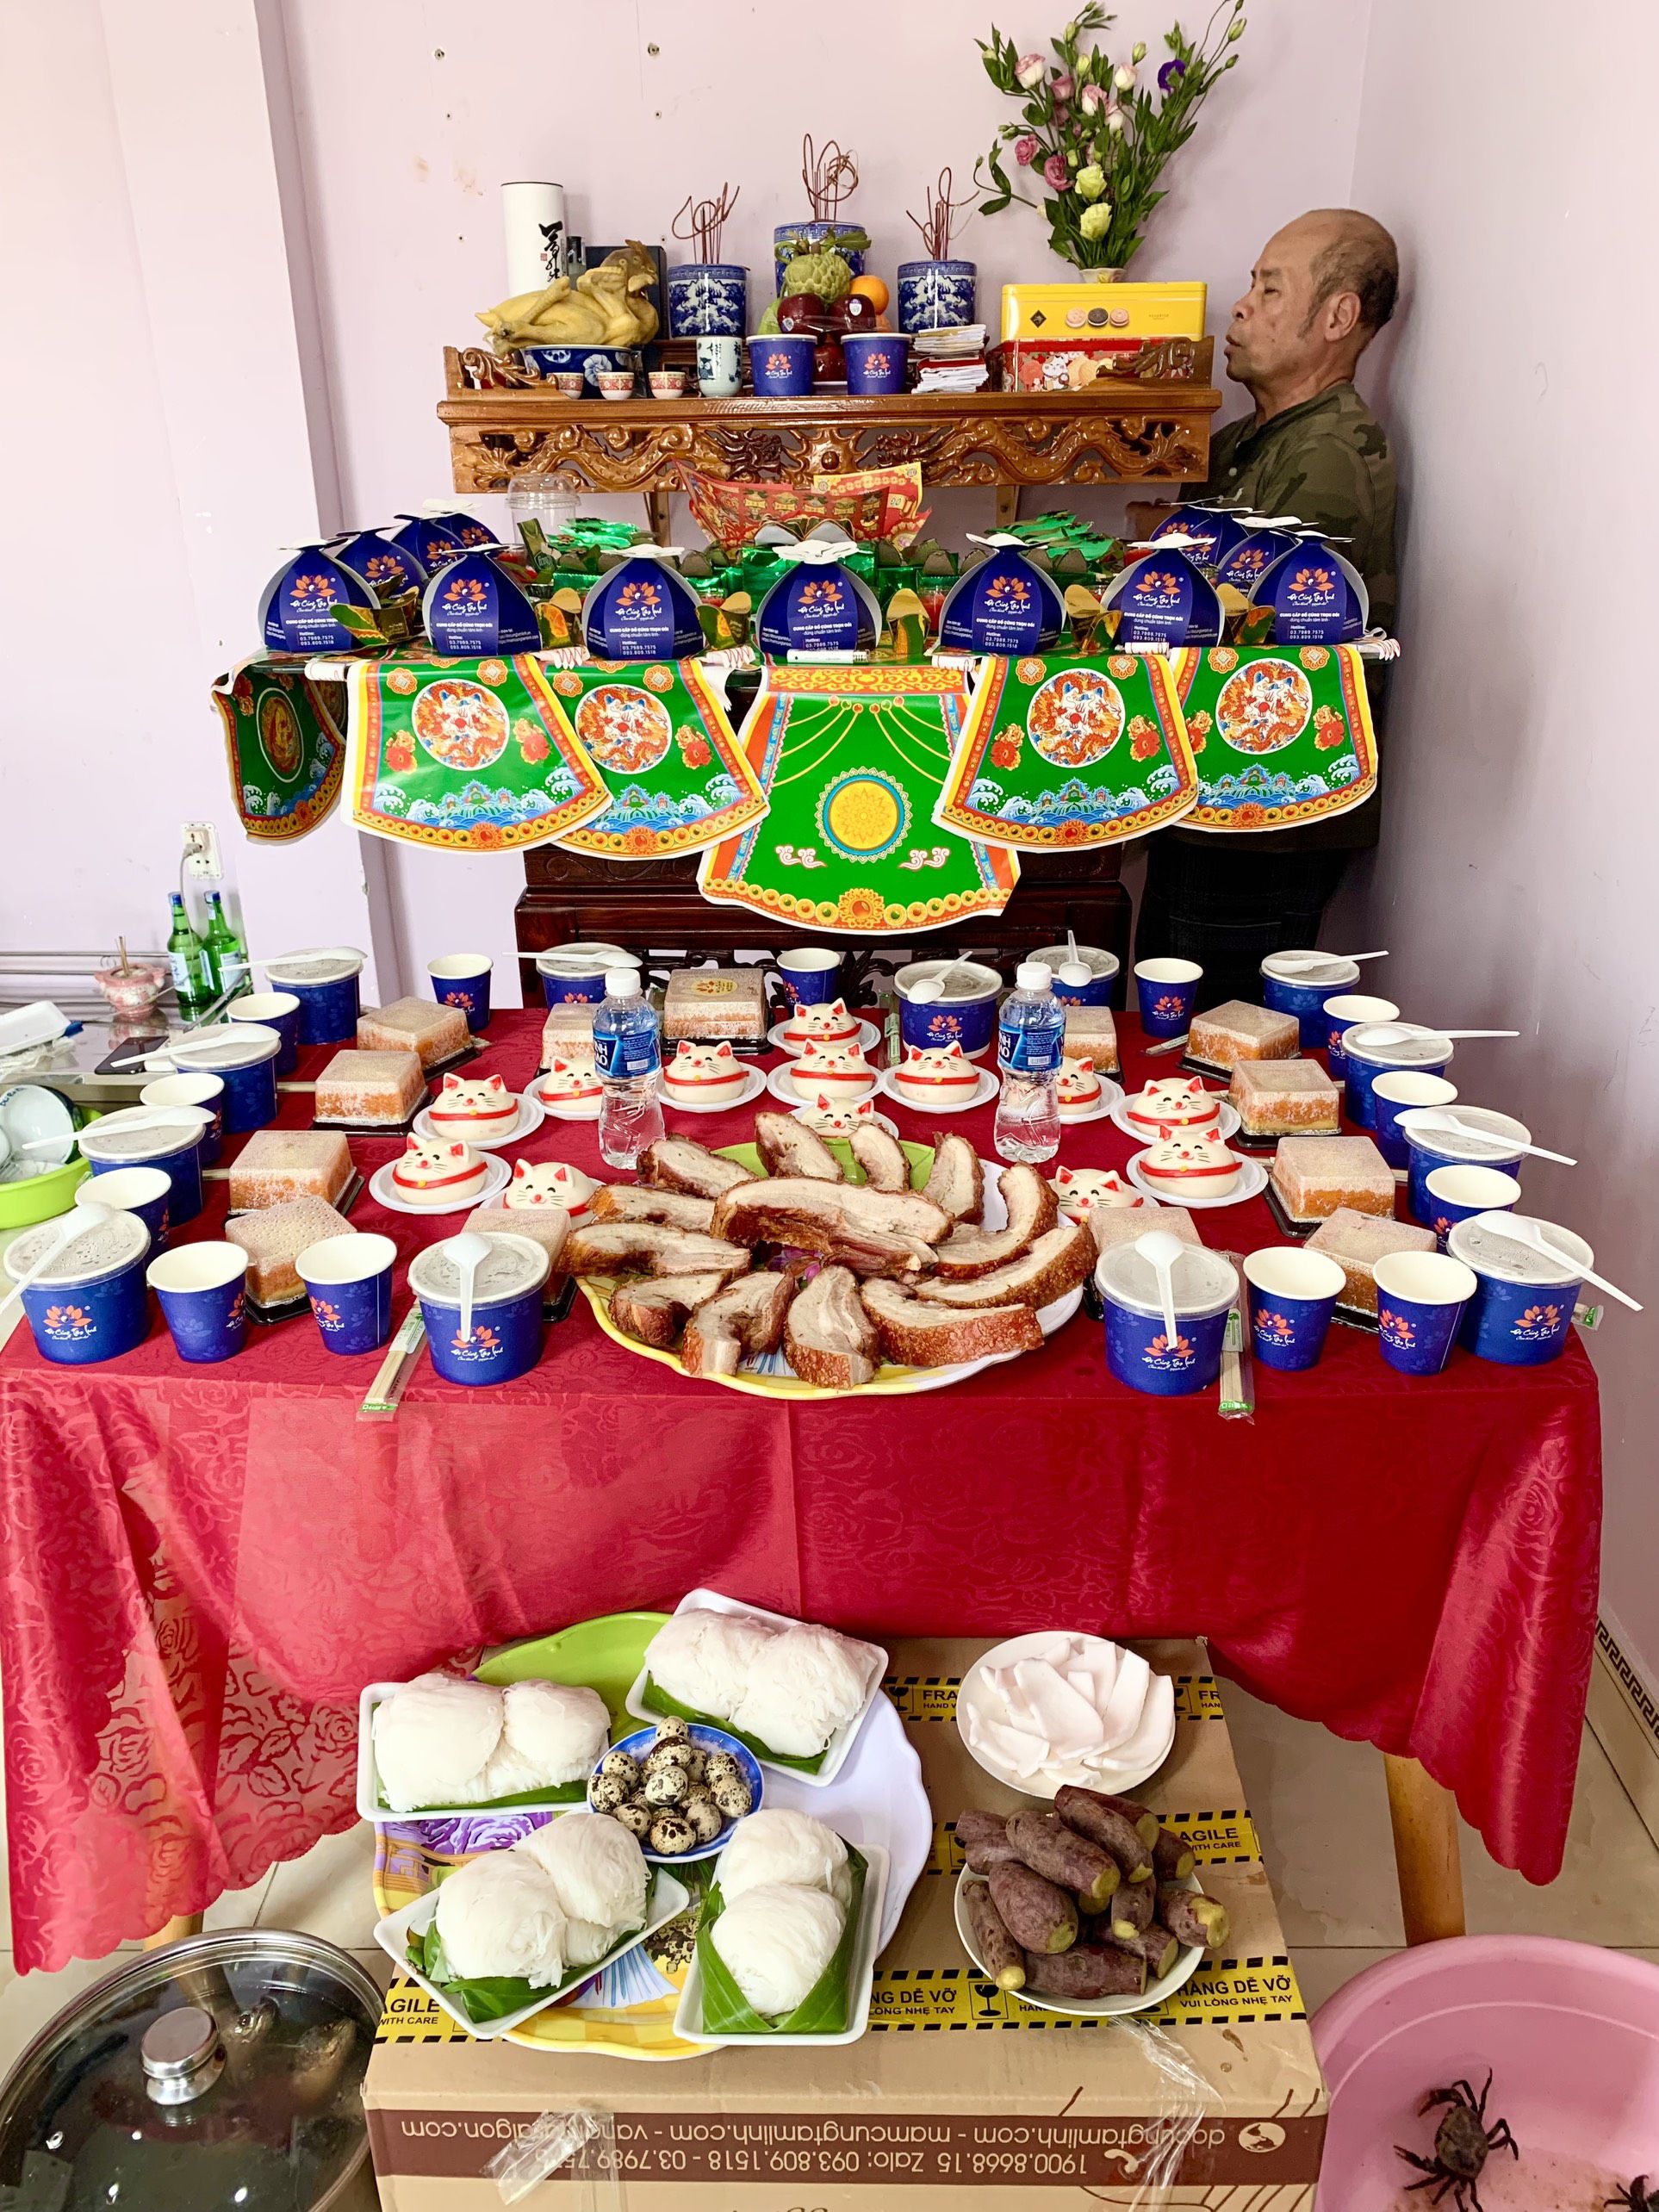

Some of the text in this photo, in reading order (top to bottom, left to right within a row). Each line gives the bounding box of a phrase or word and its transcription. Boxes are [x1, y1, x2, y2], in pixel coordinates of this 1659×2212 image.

[1180, 1828, 1239, 1842] AGILE
[870, 1987, 957, 2004] NG DỄ VỠ
[1178, 1974, 1291, 1998] HÀNG DỄ VỠ
[1179, 1994, 1293, 2009] VUI LÒNG NHẸ TAY
[407, 2016, 438, 2025] CARE
[904, 2006, 930, 2017] NHẸ
[934, 2006, 955, 2015] TAY
[669, 2120, 949, 2146] mamcungtamlinh.com
[707, 2149, 860, 2172] 093.809.1518
[867, 2151, 923, 2172] Zalo:
[936, 2152, 1087, 2174] 1900.8668.15
